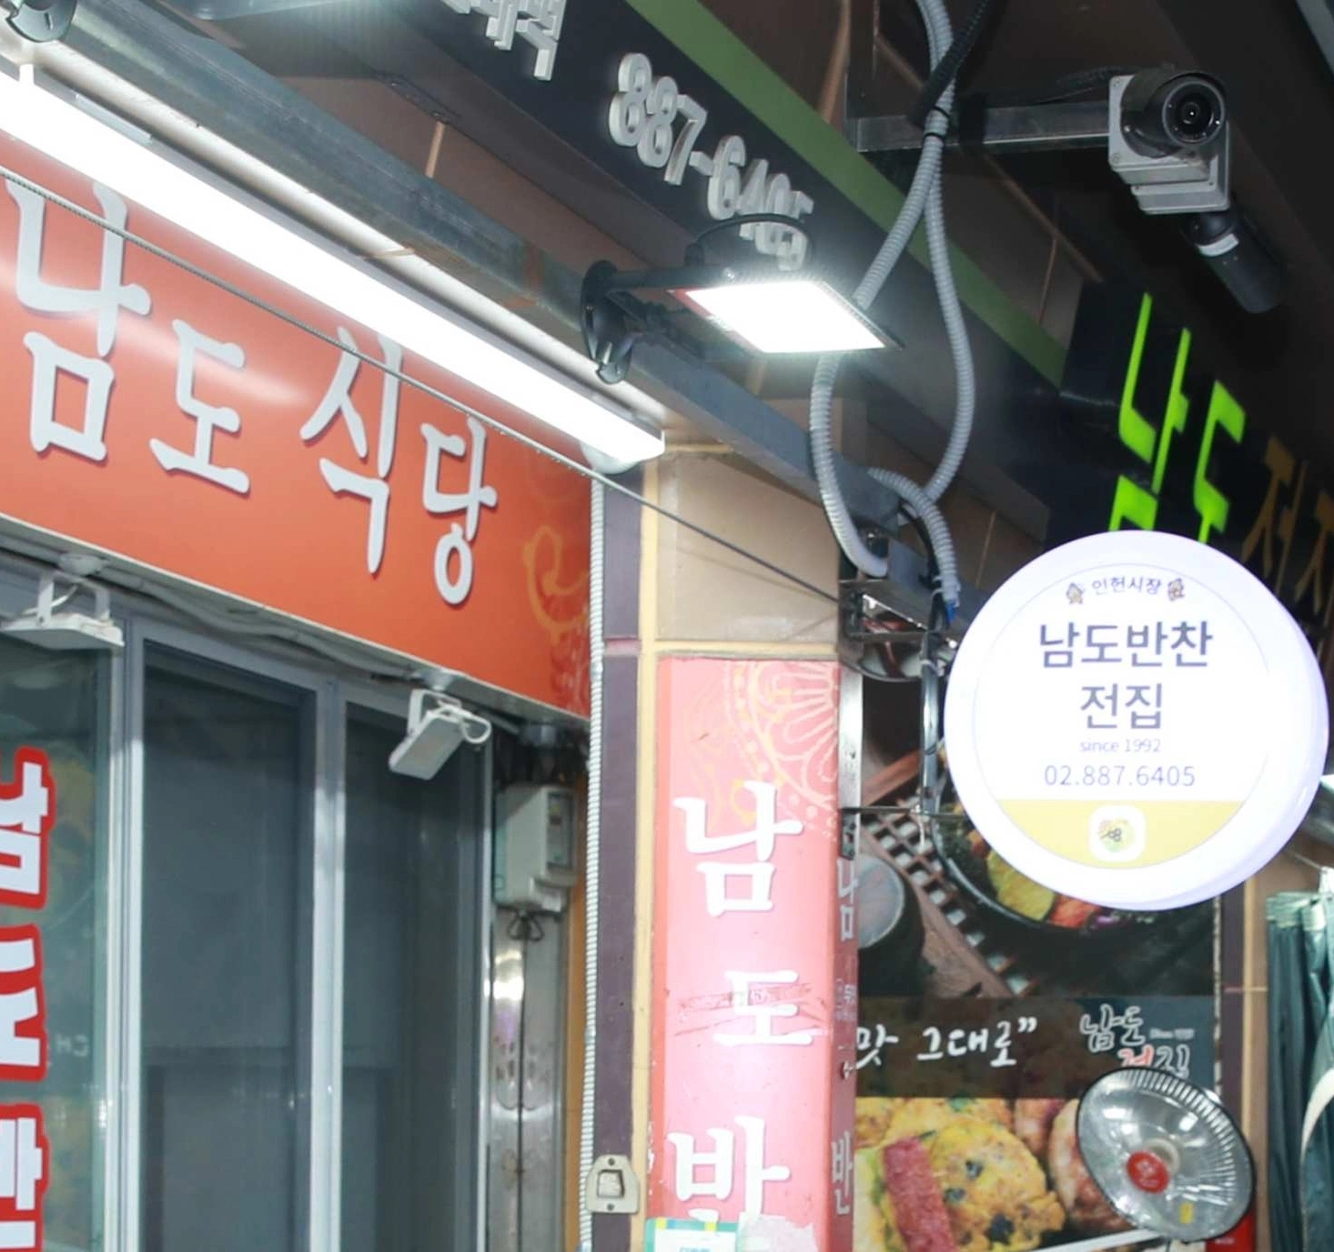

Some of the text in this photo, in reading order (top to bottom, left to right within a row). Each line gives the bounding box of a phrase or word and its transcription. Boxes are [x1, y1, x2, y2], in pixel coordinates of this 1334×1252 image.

[609, 53, 814, 271] 887-6405
[1091, 575, 1164, 597] 인헌시장
[1039, 620, 1214, 668] 남도반찬
[1079, 682, 1163, 730] 전집
[1080, 738, 1162, 753] since 1992
[1043, 764, 1197, 789] 02.887.6405
[1078, 1002, 1147, 1054] 남도
